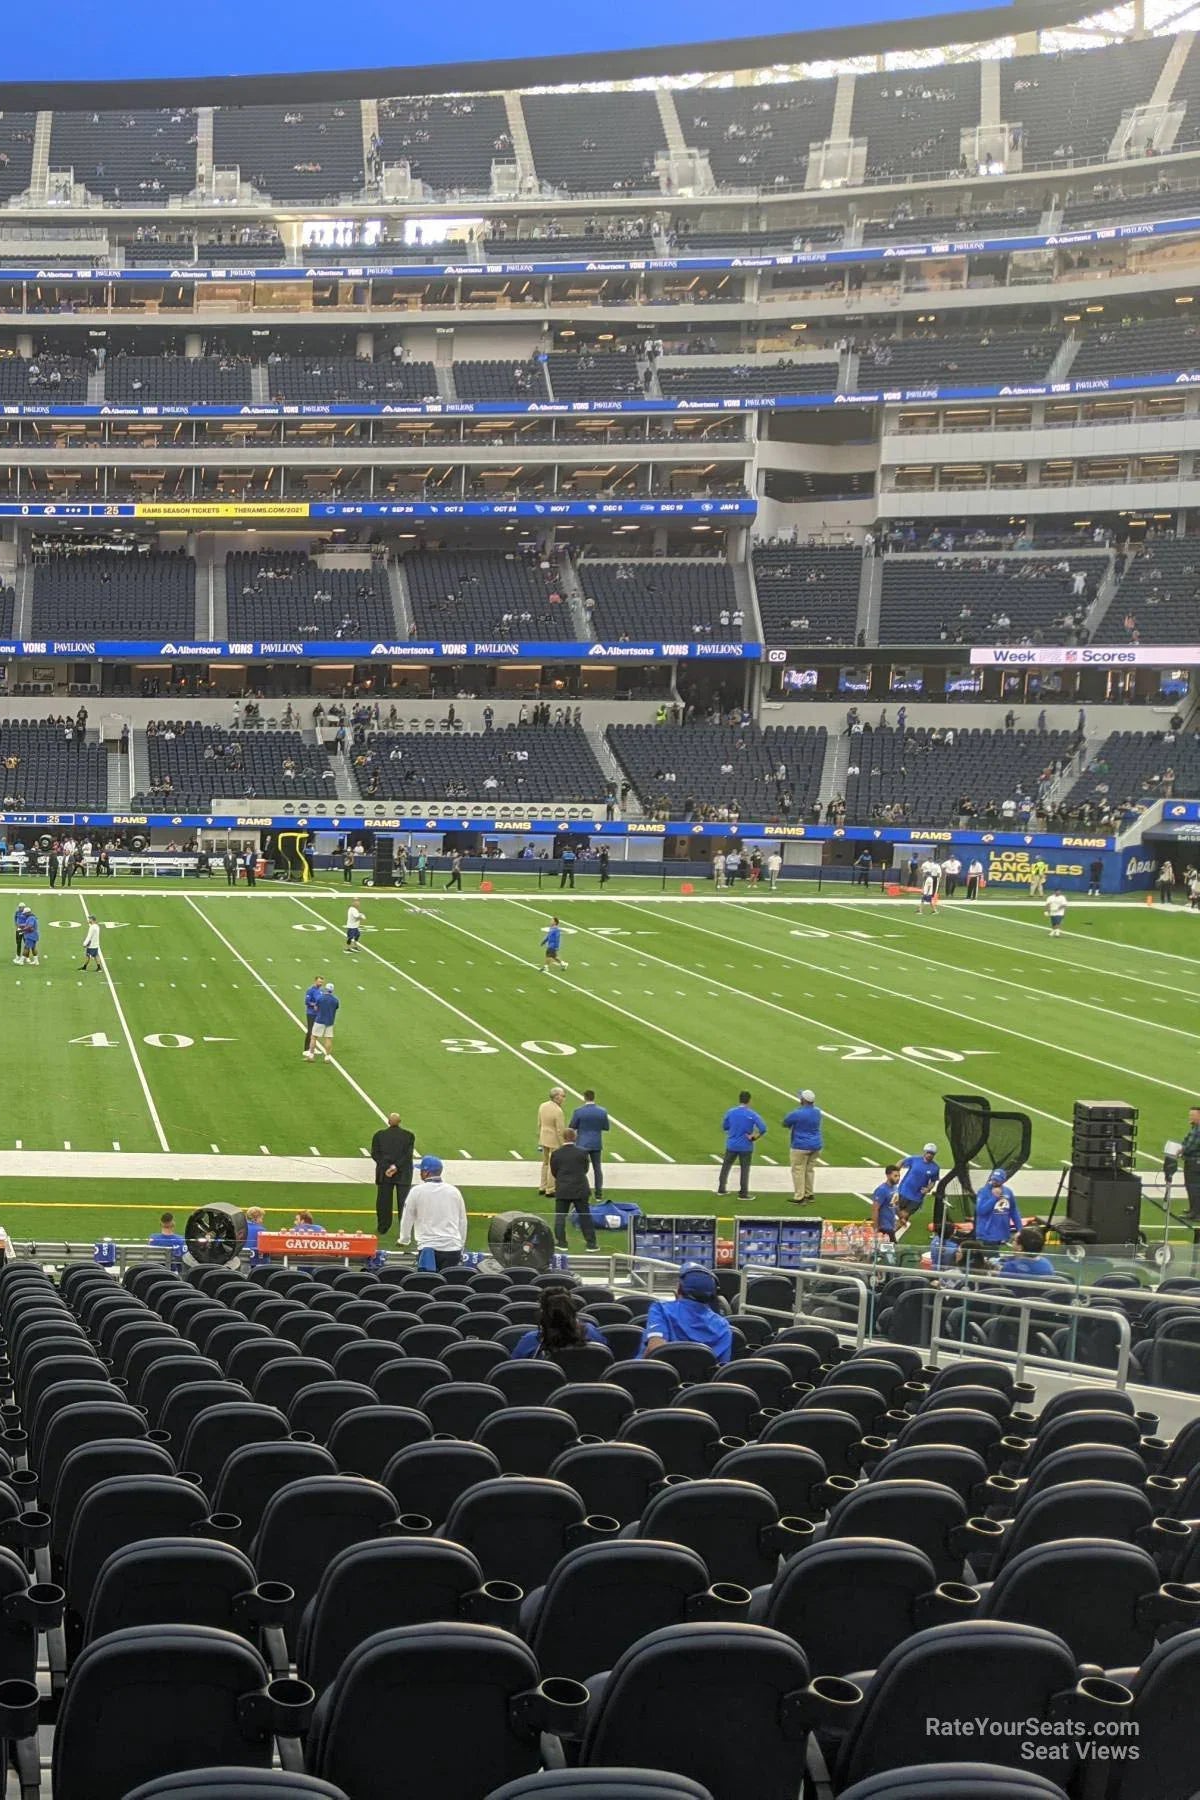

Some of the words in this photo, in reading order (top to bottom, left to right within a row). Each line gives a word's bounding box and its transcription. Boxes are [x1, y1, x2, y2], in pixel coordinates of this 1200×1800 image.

[22, 643, 46, 653] VONS
[54, 643, 96, 653] PAVILIONS
[176, 645, 222, 655] Albertsons
[228, 644, 254, 654] VONS
[260, 644, 302, 654] PAVILIONS
[386, 645, 434, 655] Albertsons
[442, 644, 468, 654] VONS
[474, 644, 518, 654] PAVILIONS
[606, 646, 654, 655] Albertsons
[662, 645, 688, 655] VONS
[696, 645, 742, 655] PAVILIONS
[769, 651, 785, 660] CC
[994, 651, 1036, 662] Week
[1082, 650, 1136, 662] Scores
[112, 816, 148, 824] RAMS
[236, 817, 272, 826] RAMS
[364, 819, 400, 827] RAMS
[494, 821, 532, 829] RAMS
[628, 824, 666, 833] RAMS
[764, 826, 806, 835] RAMS
[910, 831, 952, 841] RAMS
[1062, 837, 1106, 849] RAMS
[990, 851, 1029, 862] LOS
[990, 862, 1083, 875] ANGLES
[68, 1032, 195, 1048] 40
[440, 1038, 578, 1056] 30
[817, 1045, 966, 1061] 20
[286, 1239, 350, 1250] GATORADE
